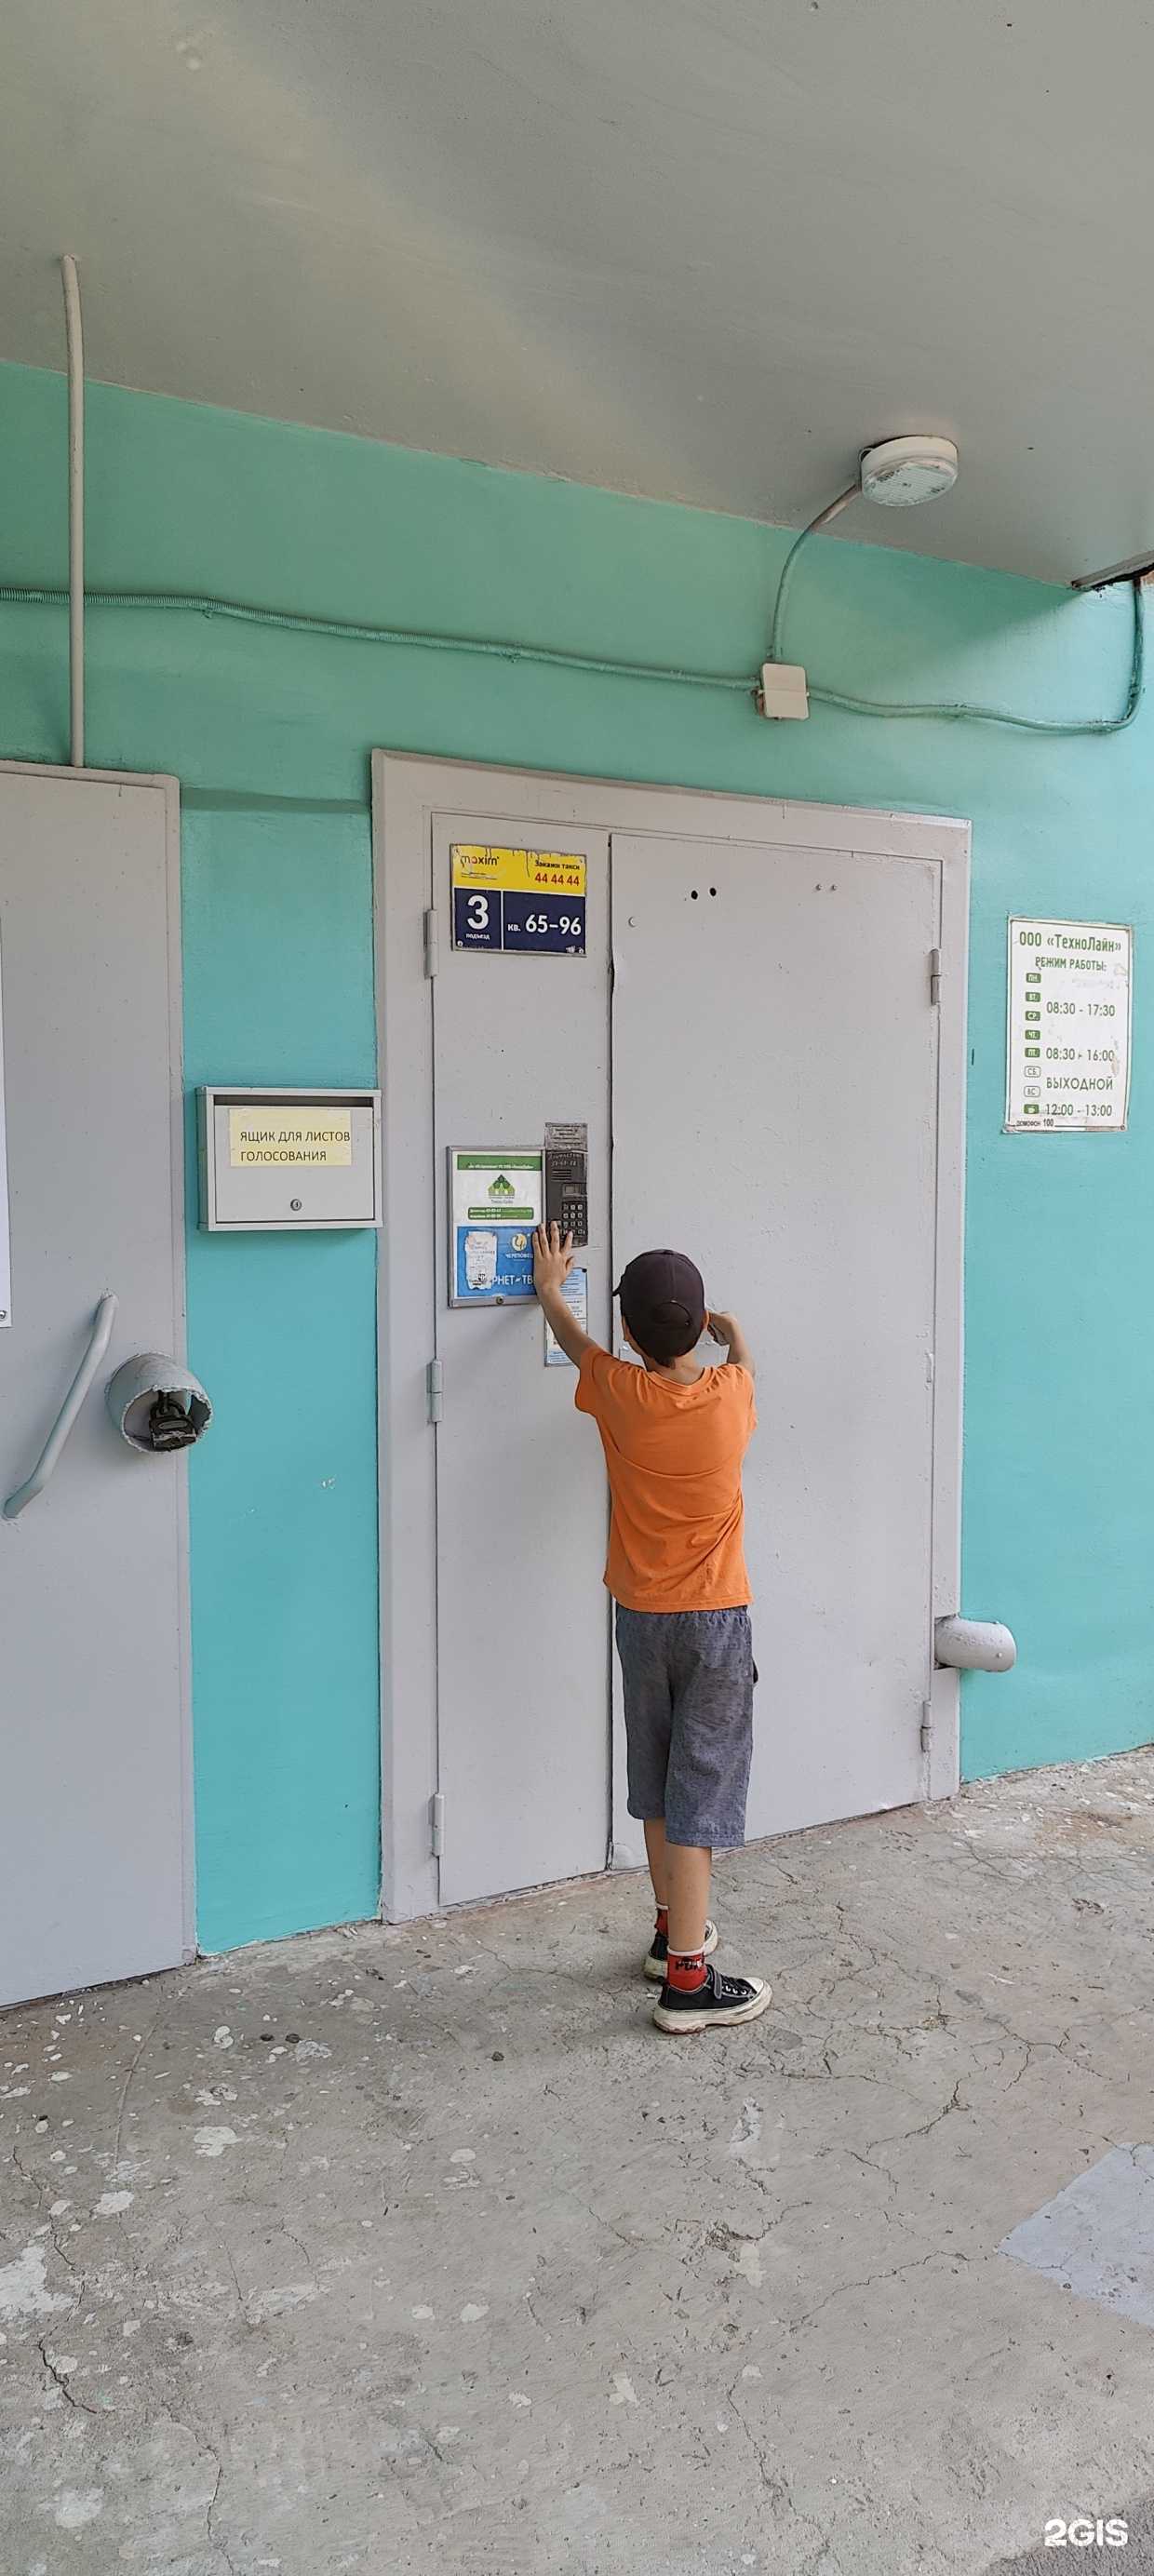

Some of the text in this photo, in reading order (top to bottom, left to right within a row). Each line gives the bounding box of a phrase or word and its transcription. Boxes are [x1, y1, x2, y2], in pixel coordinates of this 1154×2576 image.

[460, 855, 498, 867] maxim
[535, 860, 560, 869] Закажи
[534, 873, 580, 887] 44 44 44
[467, 894, 490, 930] 3
[507, 914, 582, 935] кв. 65-96
[1019, 932, 1121, 952] ООО «ТехноЛайн»
[1035, 957, 1107, 971] РЕЖИМ РАБОТЫ:
[1046, 1001, 1076, 1014] 08:30
[1087, 1003, 1116, 1017] 17:30
[1046, 1048, 1076, 1060] 08:30
[1087, 1050, 1115, 1061] 16:00
[1046, 1076, 1113, 1091] ВЫХОДНОЙ
[1045, 1104, 1074, 1116] 12:00
[1086, 1105, 1112, 1116] 13:00
[1043, 1119, 1053, 1127] 100
[240, 1132, 350, 1143] ЯЩИК ДЛЯ ЛИСТОВ
[240, 1151, 327, 1162] ГОЛОСОВАНИЯ
